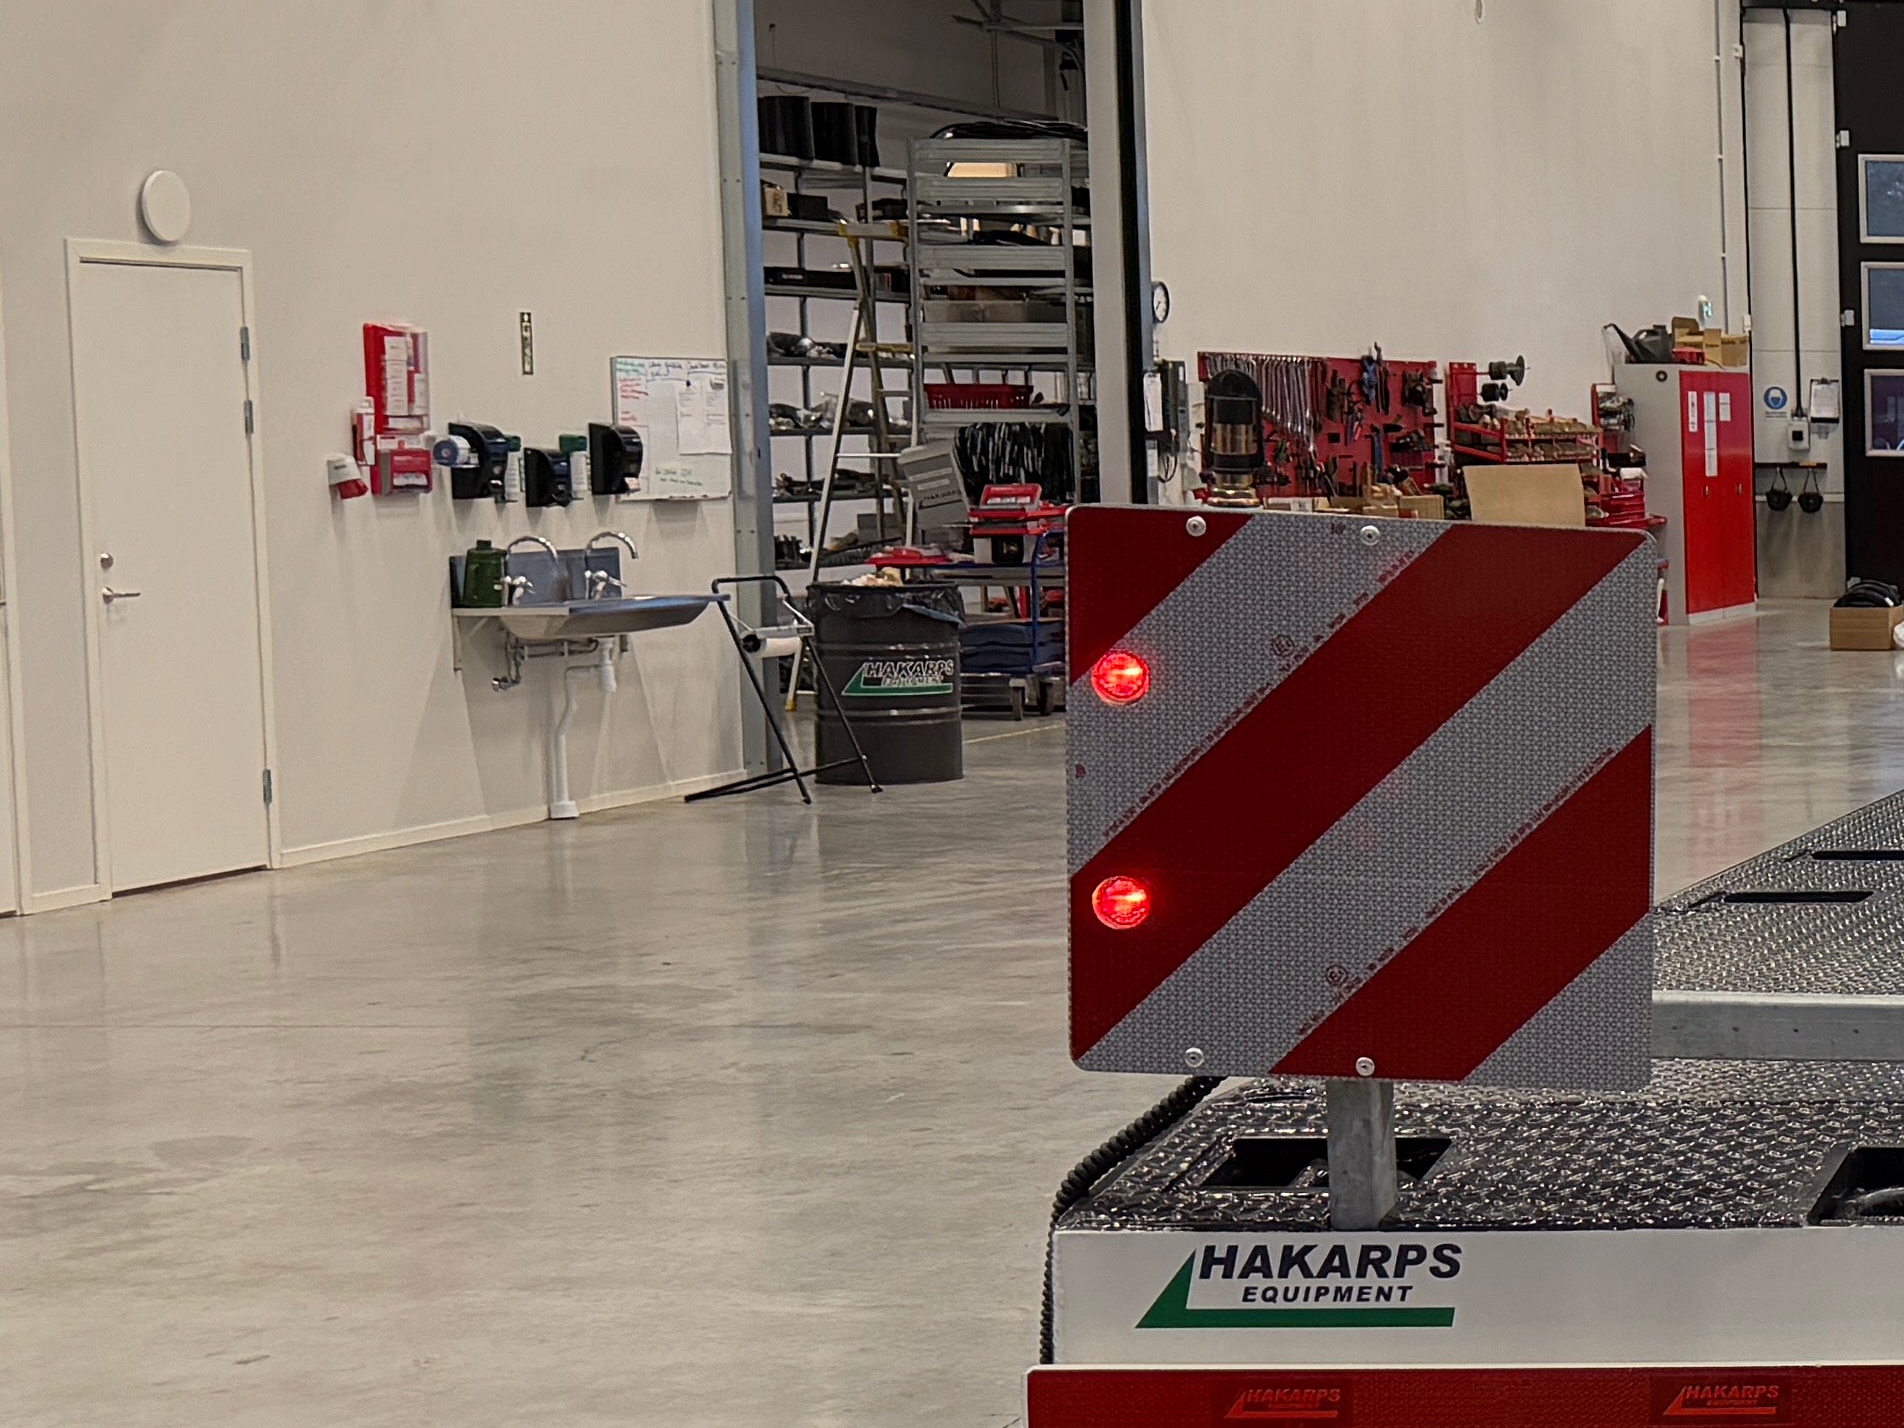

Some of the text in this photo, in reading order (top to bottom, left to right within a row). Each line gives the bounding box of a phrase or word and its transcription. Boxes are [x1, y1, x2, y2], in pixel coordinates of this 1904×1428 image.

[864, 659, 953, 678] HAKARPS
[1199, 1243, 1463, 1281] HAKARPS
[1241, 1285, 1414, 1304] EQUIPMENT
[1247, 1388, 1341, 1403] HAKARPS
[1686, 1385, 1779, 1400] HAKARPS
